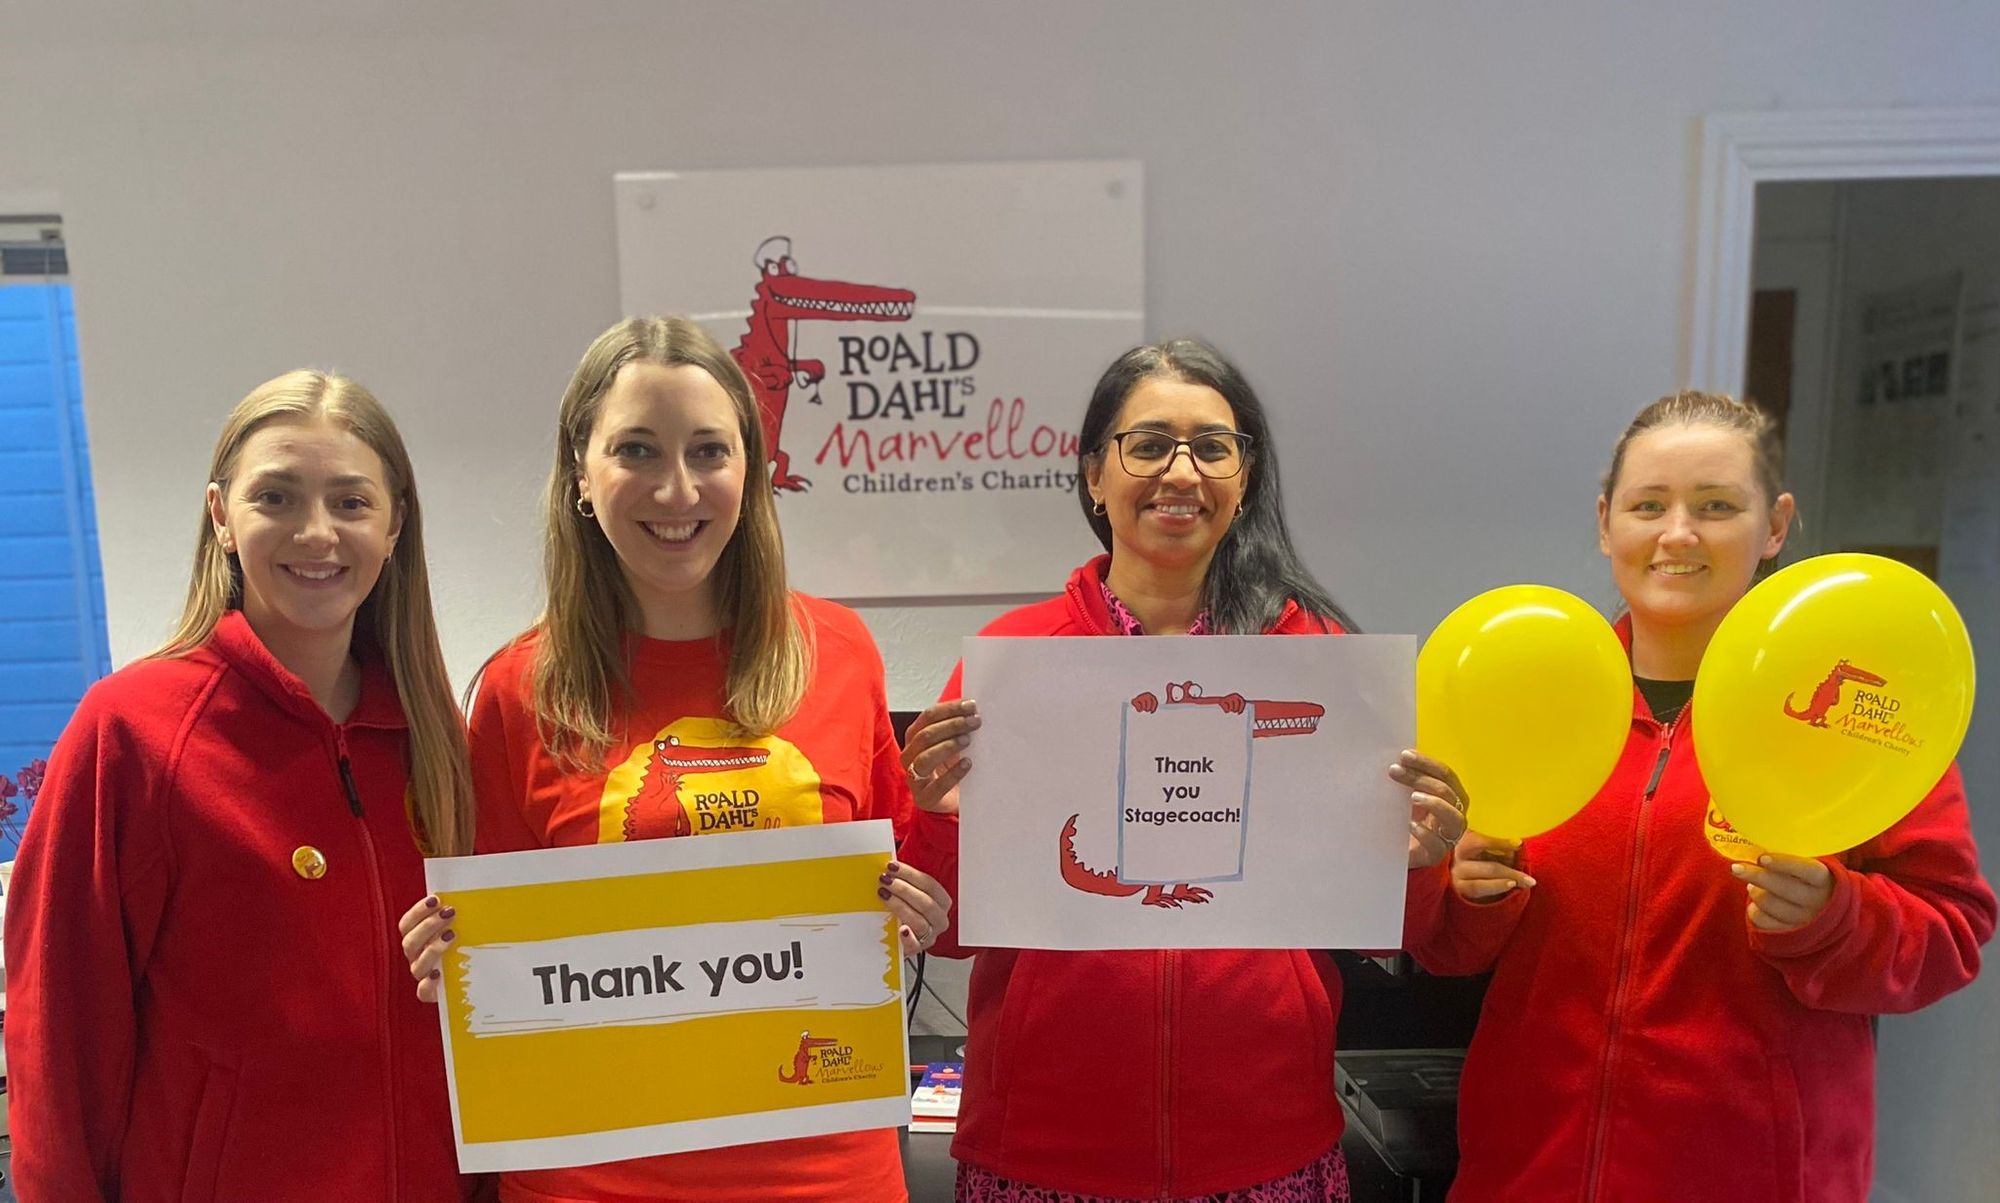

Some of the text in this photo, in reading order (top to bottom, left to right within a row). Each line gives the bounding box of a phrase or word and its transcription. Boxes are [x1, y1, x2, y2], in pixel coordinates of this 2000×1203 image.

[838, 331, 980, 375] ROALD
[846, 376, 976, 420] DAHL'S
[815, 397, 1080, 473] Marvellou
[843, 468, 1081, 494] Children's Charity
[1854, 690, 1900, 713] ROALD
[1155, 756, 1214, 773] Thank
[694, 789, 760, 812] ROALD
[1162, 786, 1200, 803] you
[1125, 808, 1240, 826] Stagecoach!
[532, 941, 804, 1005] Thank you!
[820, 1046, 853, 1059] ROALD
[815, 1059, 884, 1078] Marvellous
